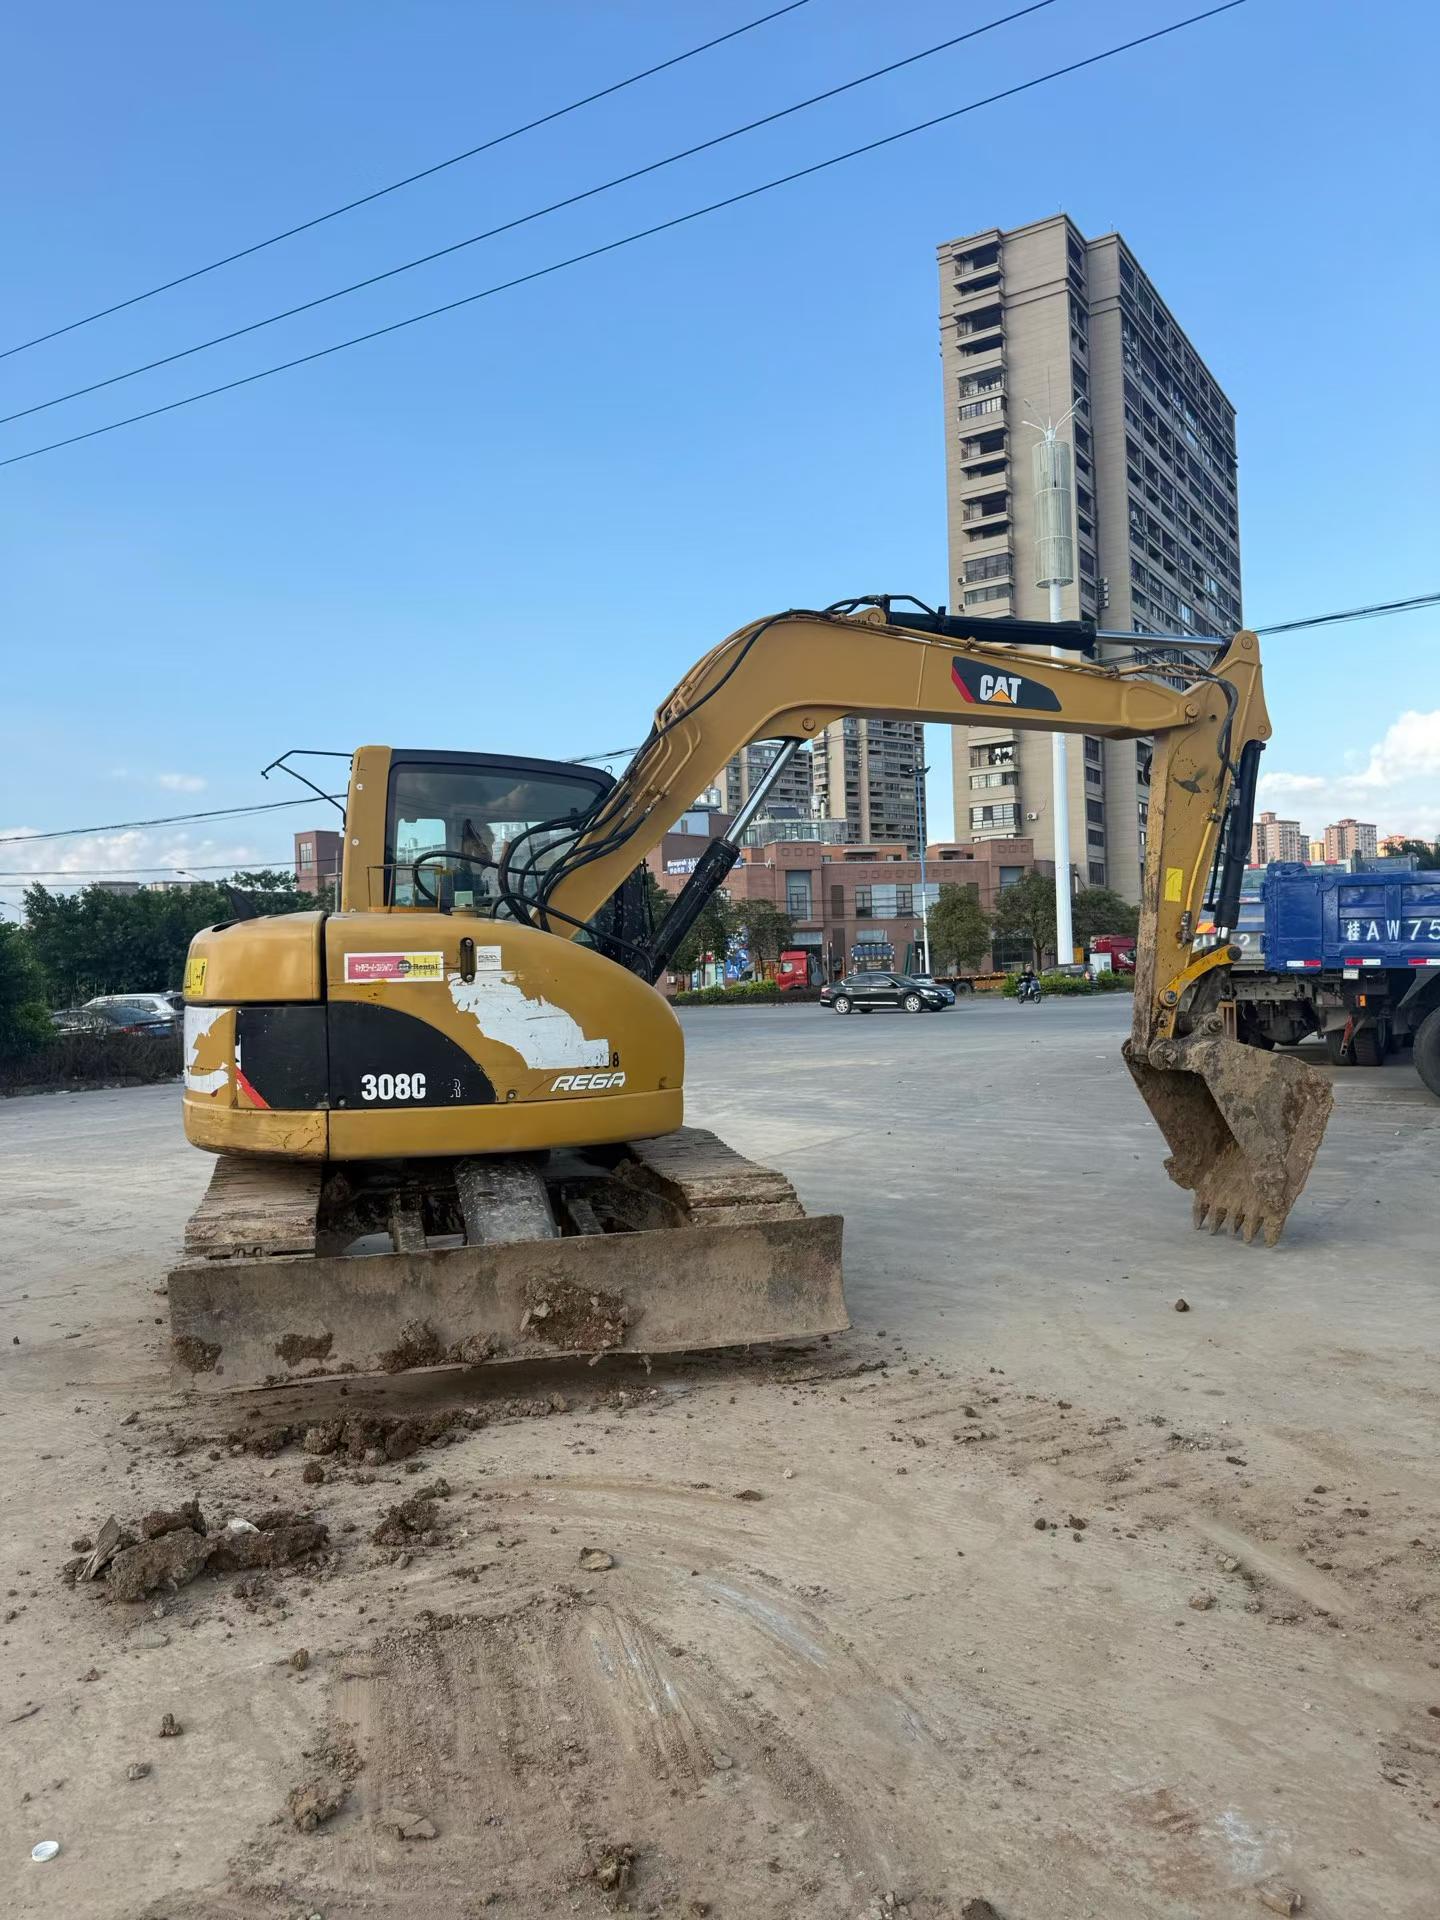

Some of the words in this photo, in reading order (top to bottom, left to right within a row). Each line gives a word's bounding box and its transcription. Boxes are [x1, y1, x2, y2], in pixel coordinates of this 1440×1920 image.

[979, 675, 1022, 704] CAT
[361, 1073, 426, 1101] 308C
[550, 1071, 626, 1092] REGA
